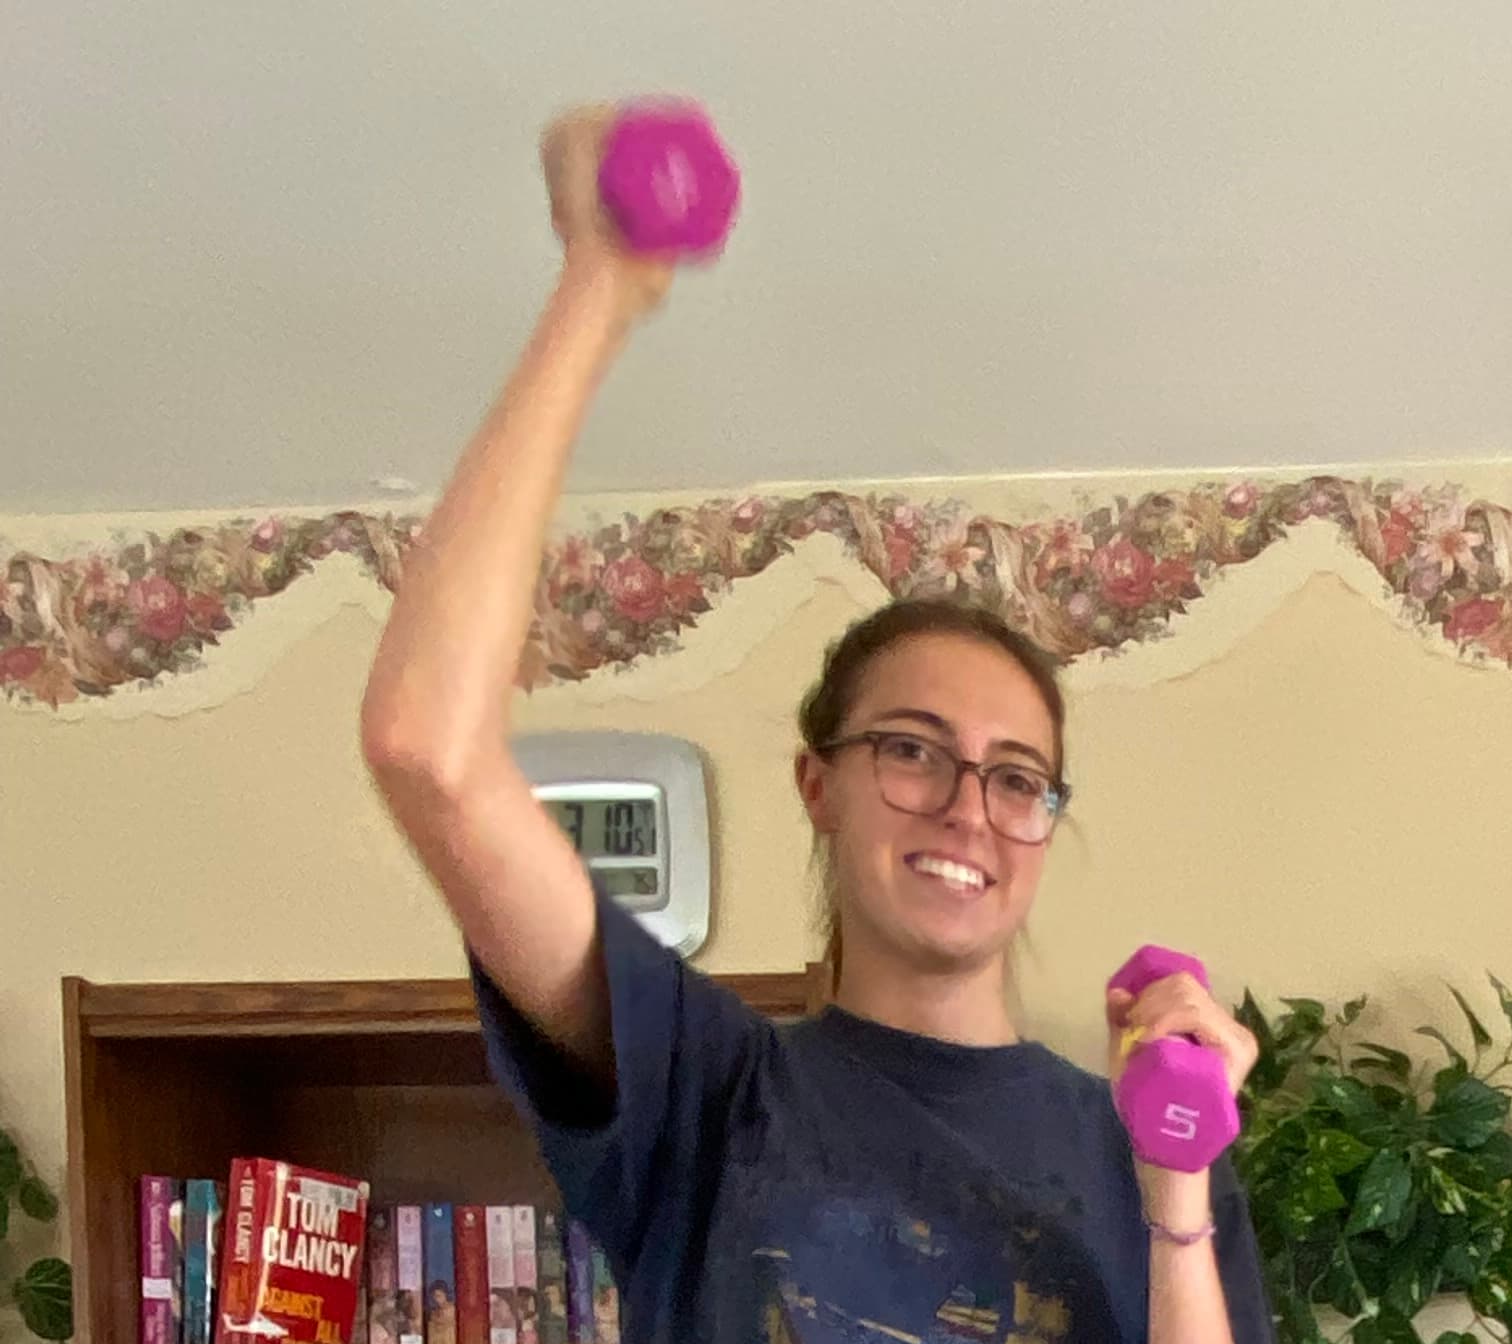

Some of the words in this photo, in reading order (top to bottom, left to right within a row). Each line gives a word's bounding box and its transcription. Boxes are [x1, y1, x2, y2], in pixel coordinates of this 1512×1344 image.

[1160, 1102, 1200, 1140] 5
[239, 1179, 255, 1208] TOM
[287, 1192, 340, 1238] TOM
[234, 1211, 253, 1264] CLANCY
[262, 1226, 358, 1280] CLANCY
